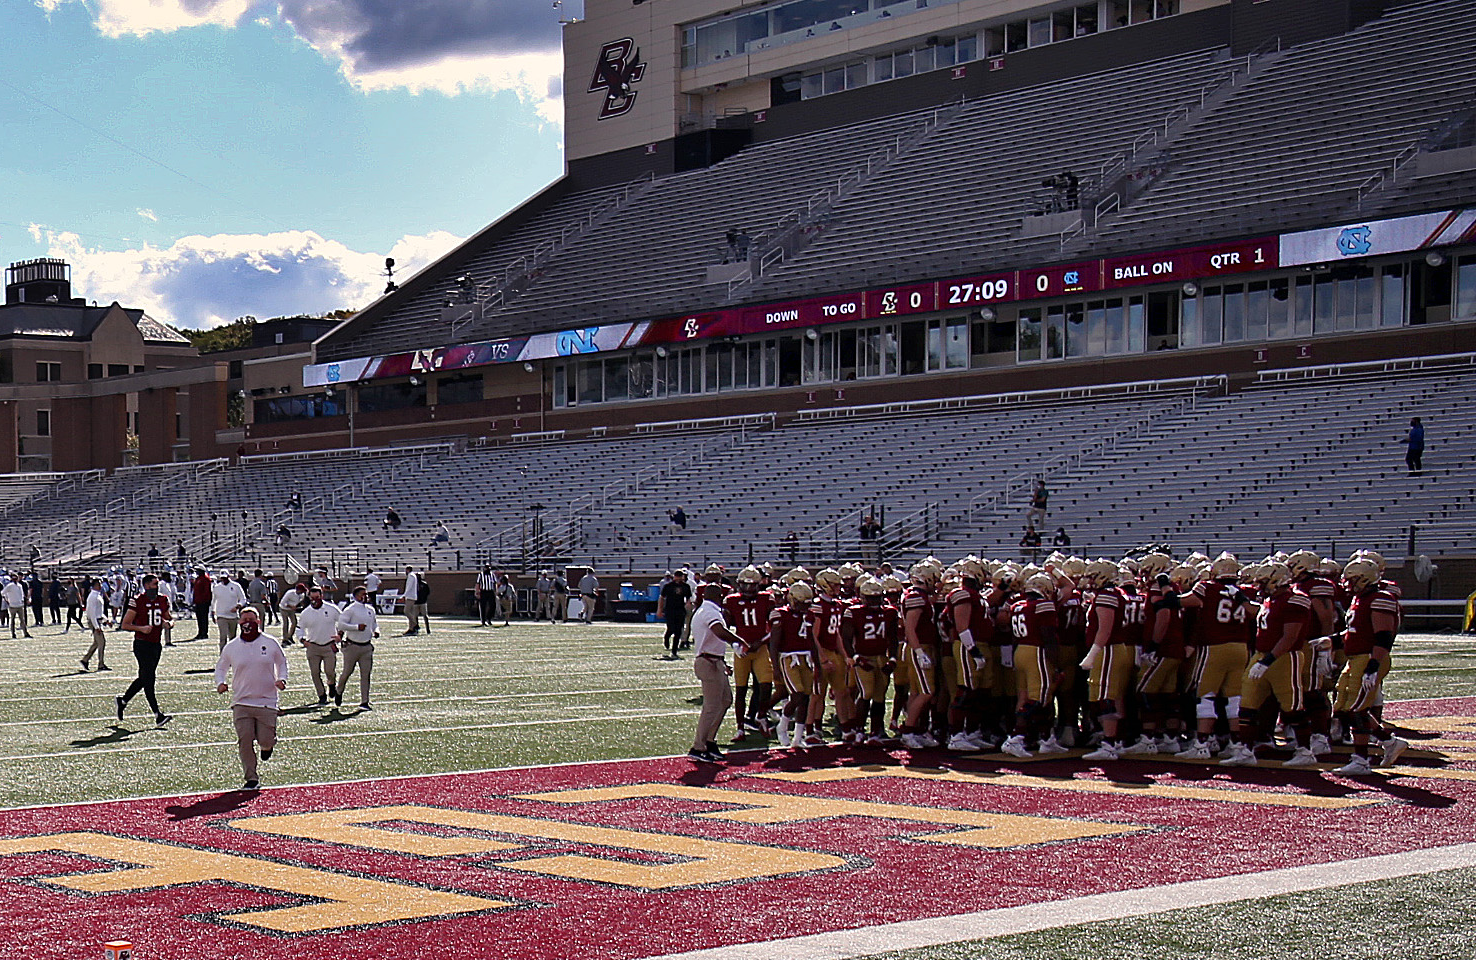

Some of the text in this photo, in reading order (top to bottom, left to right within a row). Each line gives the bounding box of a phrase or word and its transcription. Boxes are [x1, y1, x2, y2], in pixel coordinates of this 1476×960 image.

[1210, 248, 1265, 269] QTR 1
[1114, 261, 1173, 280] BALL ON
[949, 280, 1007, 304] 27:09
[1036, 275, 1049, 292] 0
[910, 292, 922, 308] 0
[766, 310, 798, 324] DOWN
[822, 303, 856, 317] TO GO
[491, 344, 509, 360] VS
[147, 608, 162, 626] 16
[741, 607, 757, 626] 11
[1216, 601, 1245, 624] 64
[798, 614, 813, 639] 4
[864, 621, 885, 640] 24
[1011, 613, 1028, 638] 66
